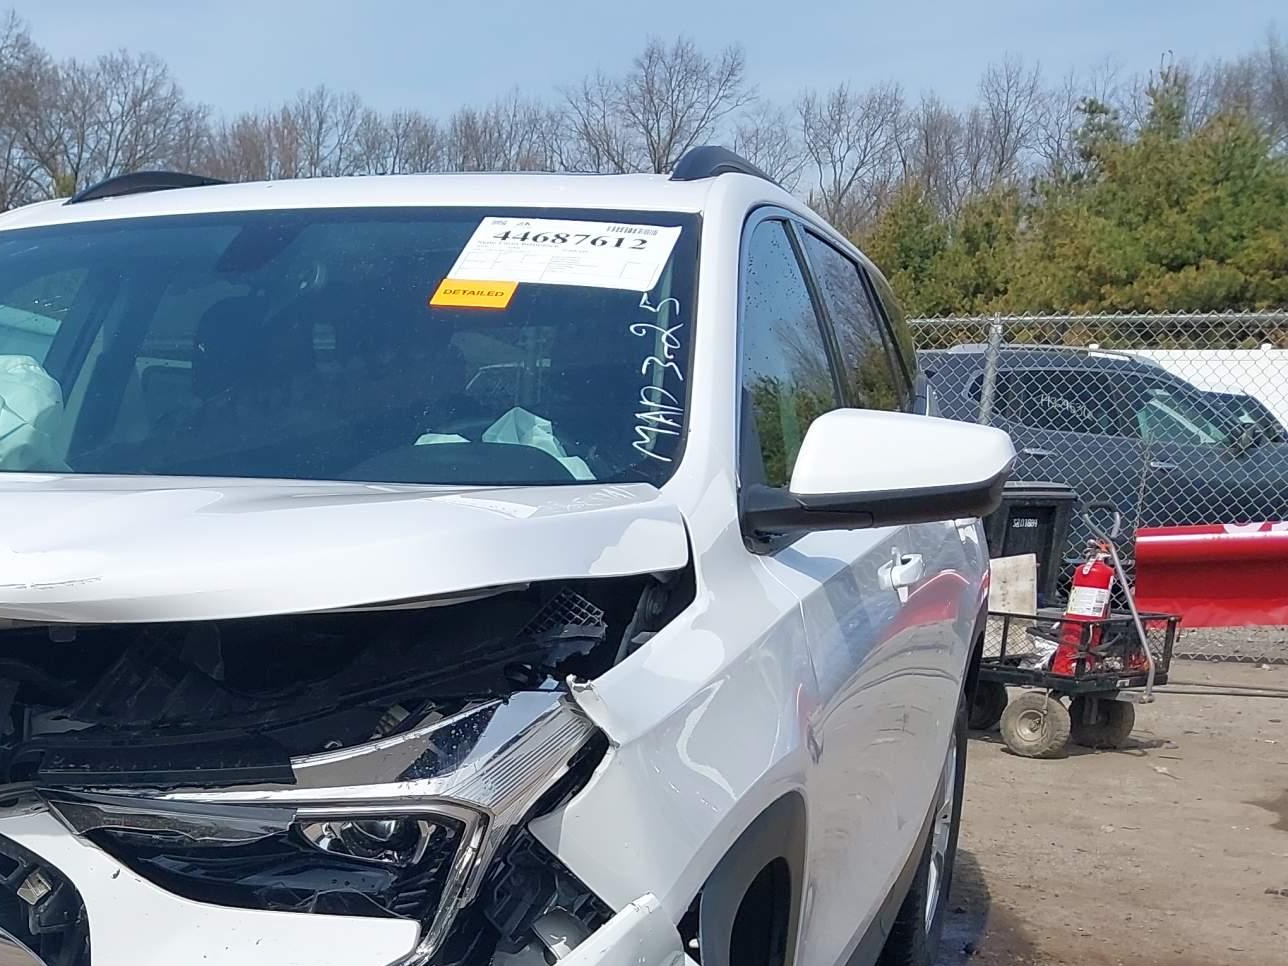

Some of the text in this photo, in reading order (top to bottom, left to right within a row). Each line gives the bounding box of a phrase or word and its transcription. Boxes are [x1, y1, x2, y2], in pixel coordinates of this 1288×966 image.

[492, 230, 648, 250] 44687612
[443, 288, 505, 298] DETAILED
[629, 292, 684, 462] MAD 325
